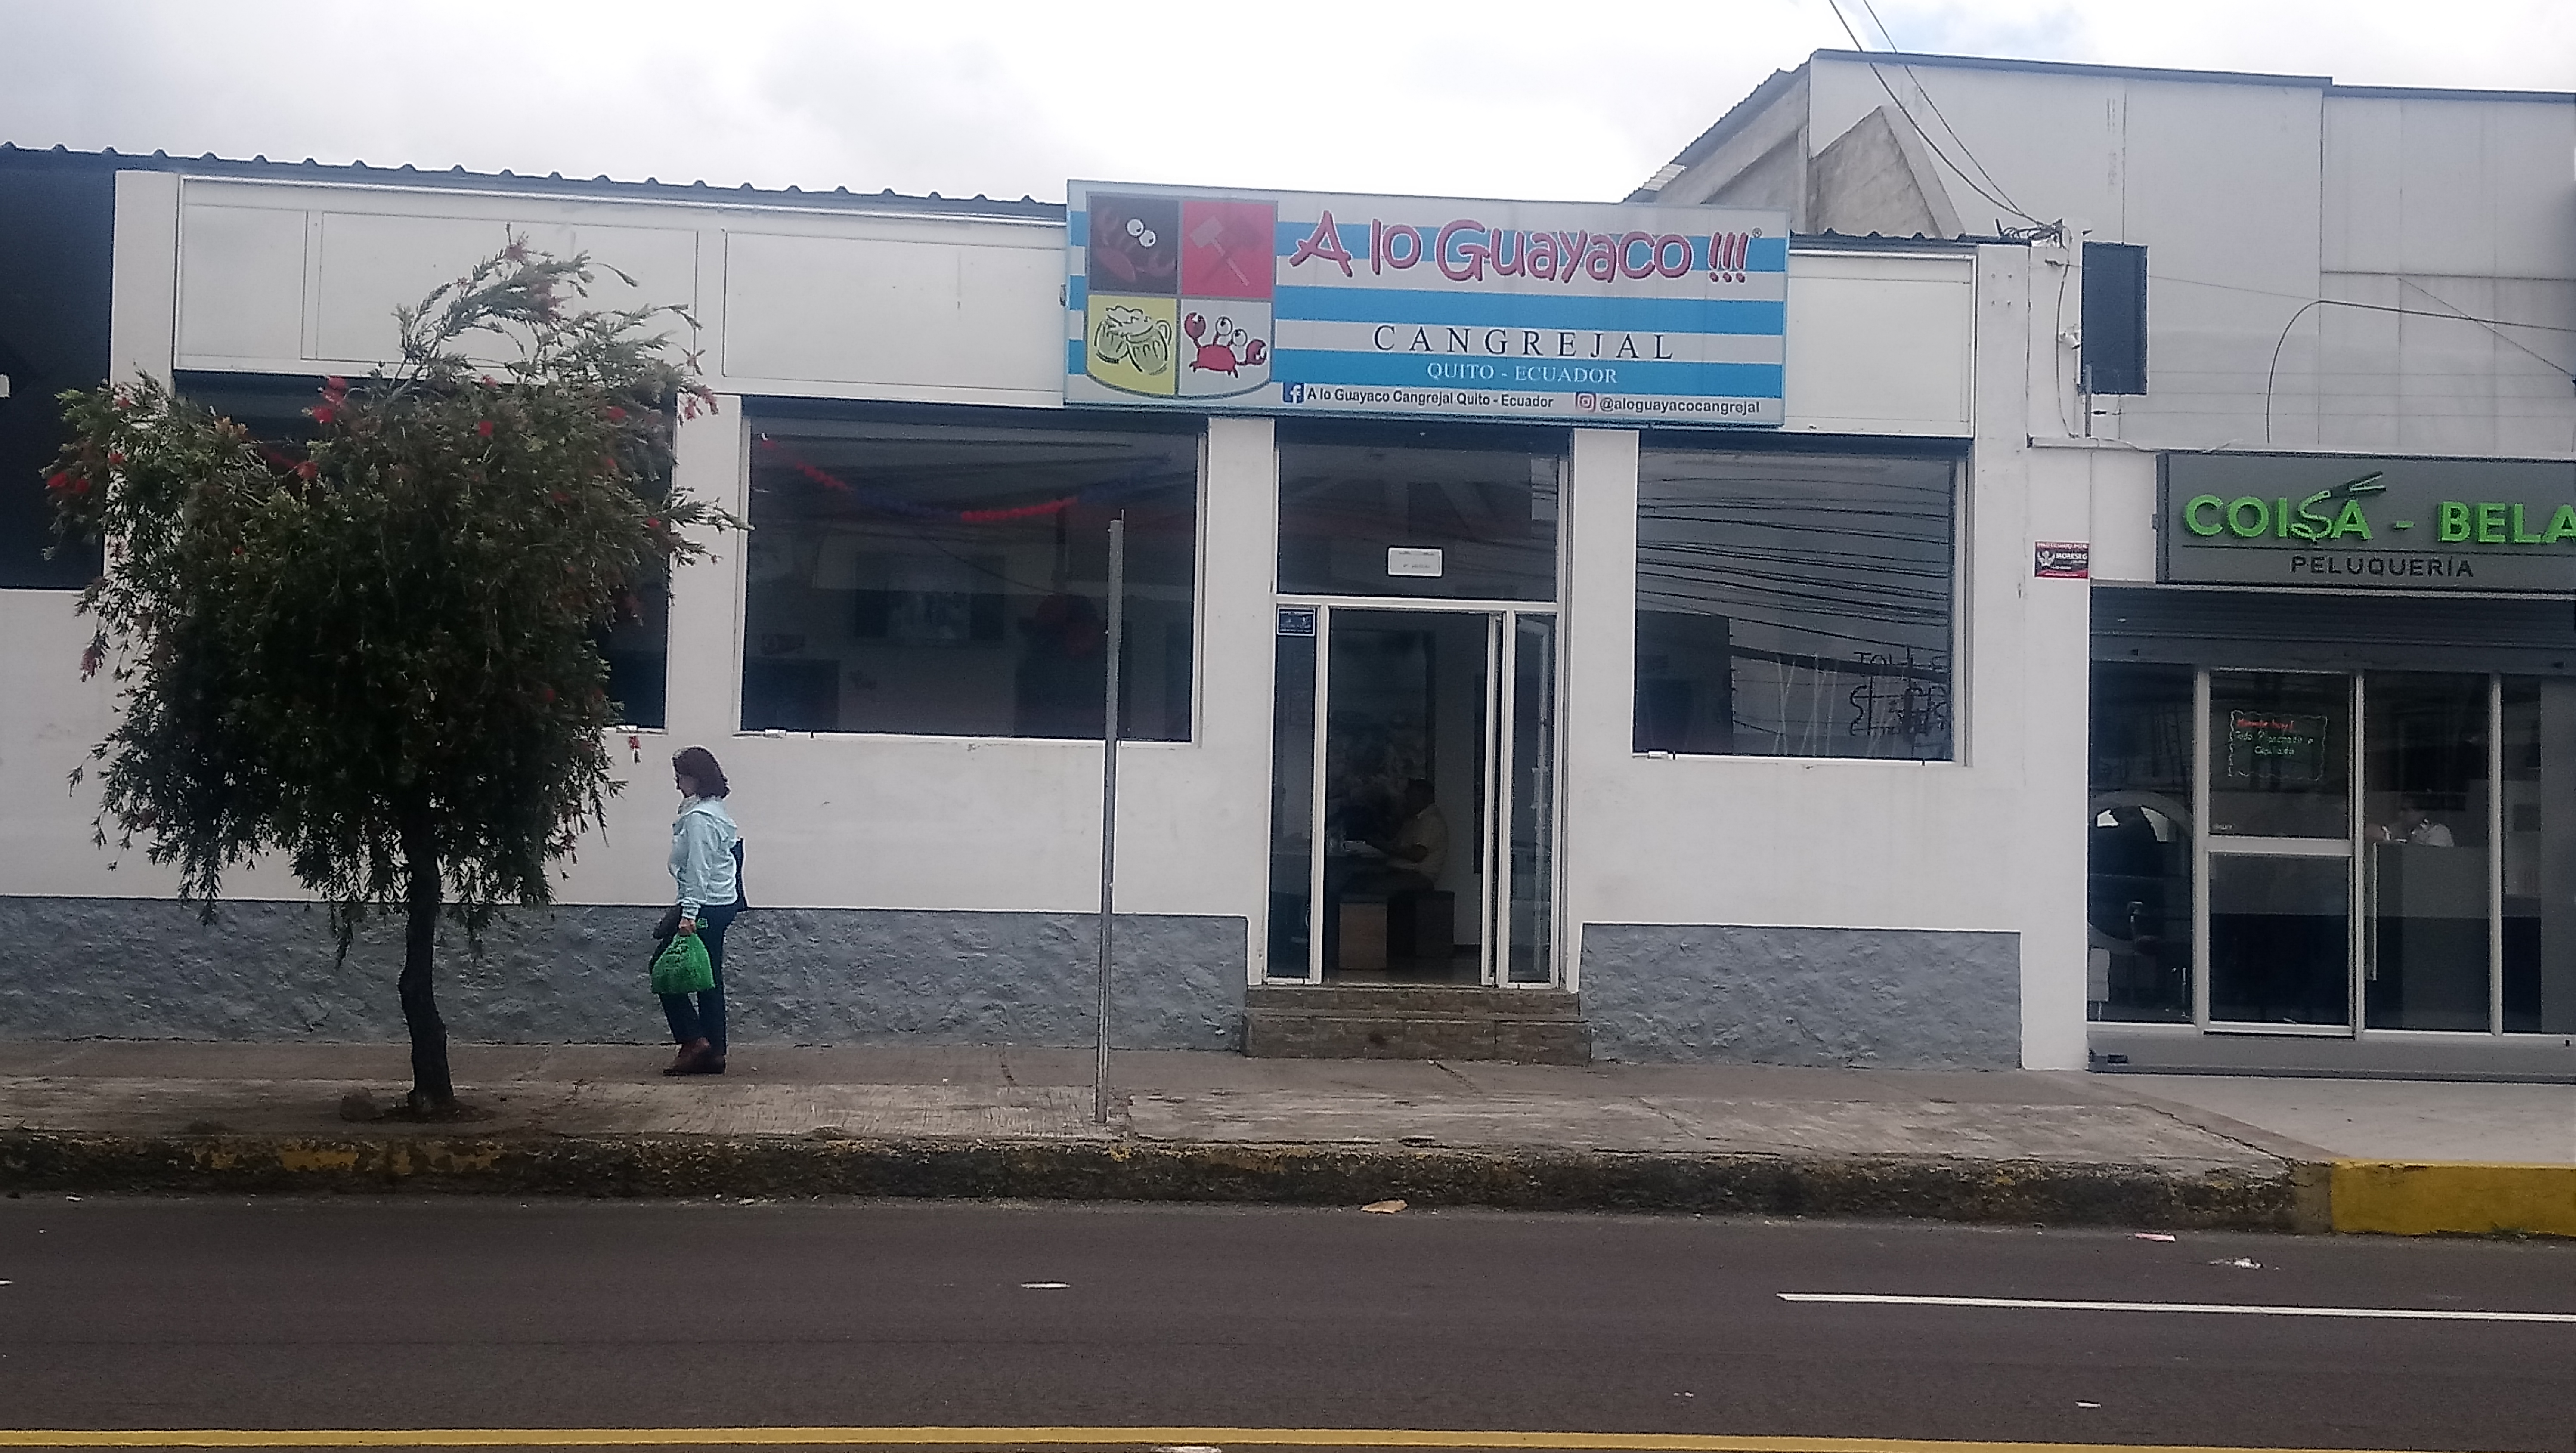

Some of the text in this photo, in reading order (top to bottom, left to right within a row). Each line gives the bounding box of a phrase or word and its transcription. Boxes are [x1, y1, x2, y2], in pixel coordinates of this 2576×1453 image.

[1289, 210, 1353, 278] A
[1369, 218, 1422, 276] lo
[1435, 218, 1693, 283] Guayaco
[1373, 325, 1673, 359] CANGREJAL
[1427, 362, 1494, 381] QUITO
[1515, 366, 1618, 384] ECUADOR
[1307, 387, 1316, 399] A
[1320, 388, 1331, 400] lo
[1334, 389, 1390, 404] Guayaco
[1393, 390, 1453, 406] Cangrejal
[1457, 392, 1490, 405] Quito
[1502, 394, 1554, 408] Ecuador
[1600, 397, 1760, 415] @aloguayacocangrejal
[2186, 490, 2373, 542] COISA
[2439, 501, 2576, 544] BELA
[2291, 556, 2474, 577] PELUQUERÍA
